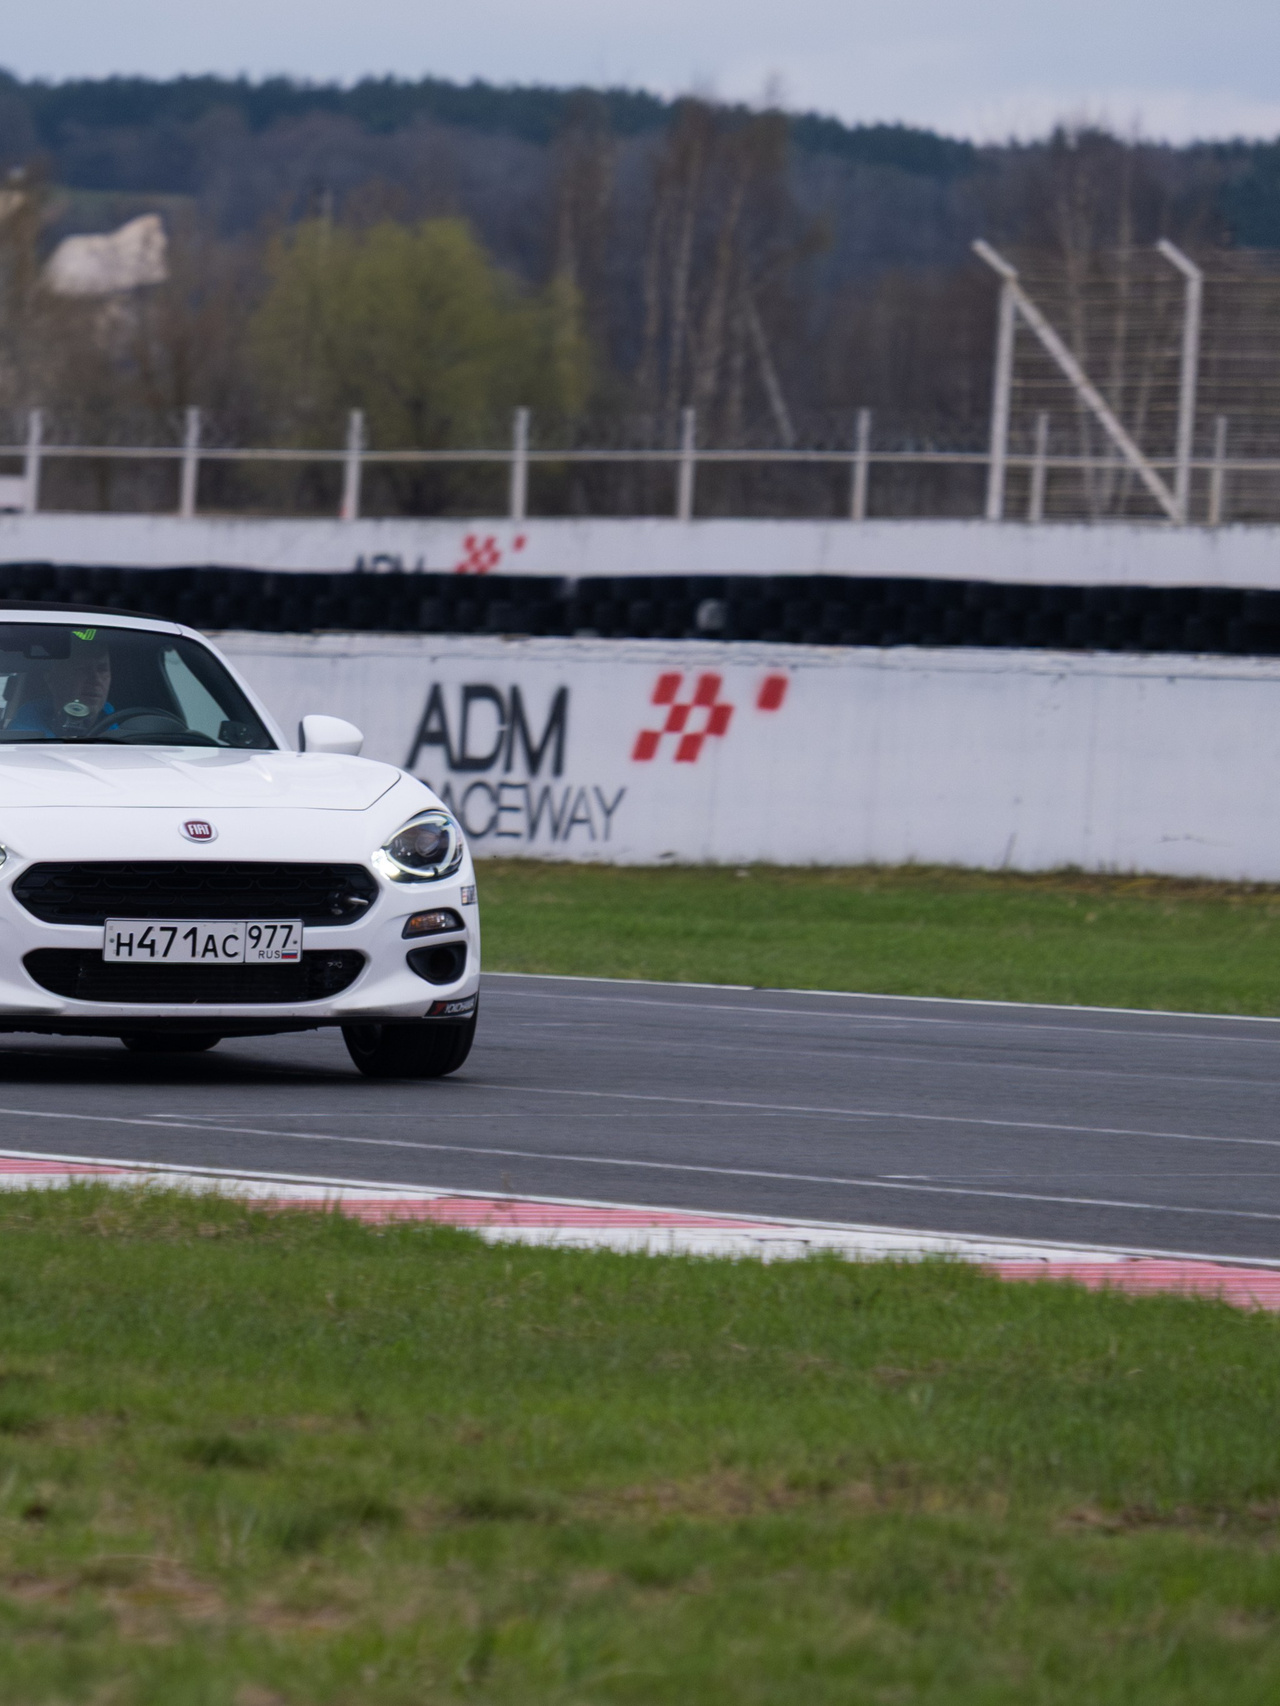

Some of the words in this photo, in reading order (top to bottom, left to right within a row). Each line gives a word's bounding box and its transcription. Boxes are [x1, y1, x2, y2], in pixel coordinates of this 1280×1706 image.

[405, 683, 570, 777] ADM
[420, 779, 627, 842] ACEWAY
[187, 823, 210, 835] FIAT
[248, 925, 294, 949] 977
[258, 950, 281, 959] RUS
